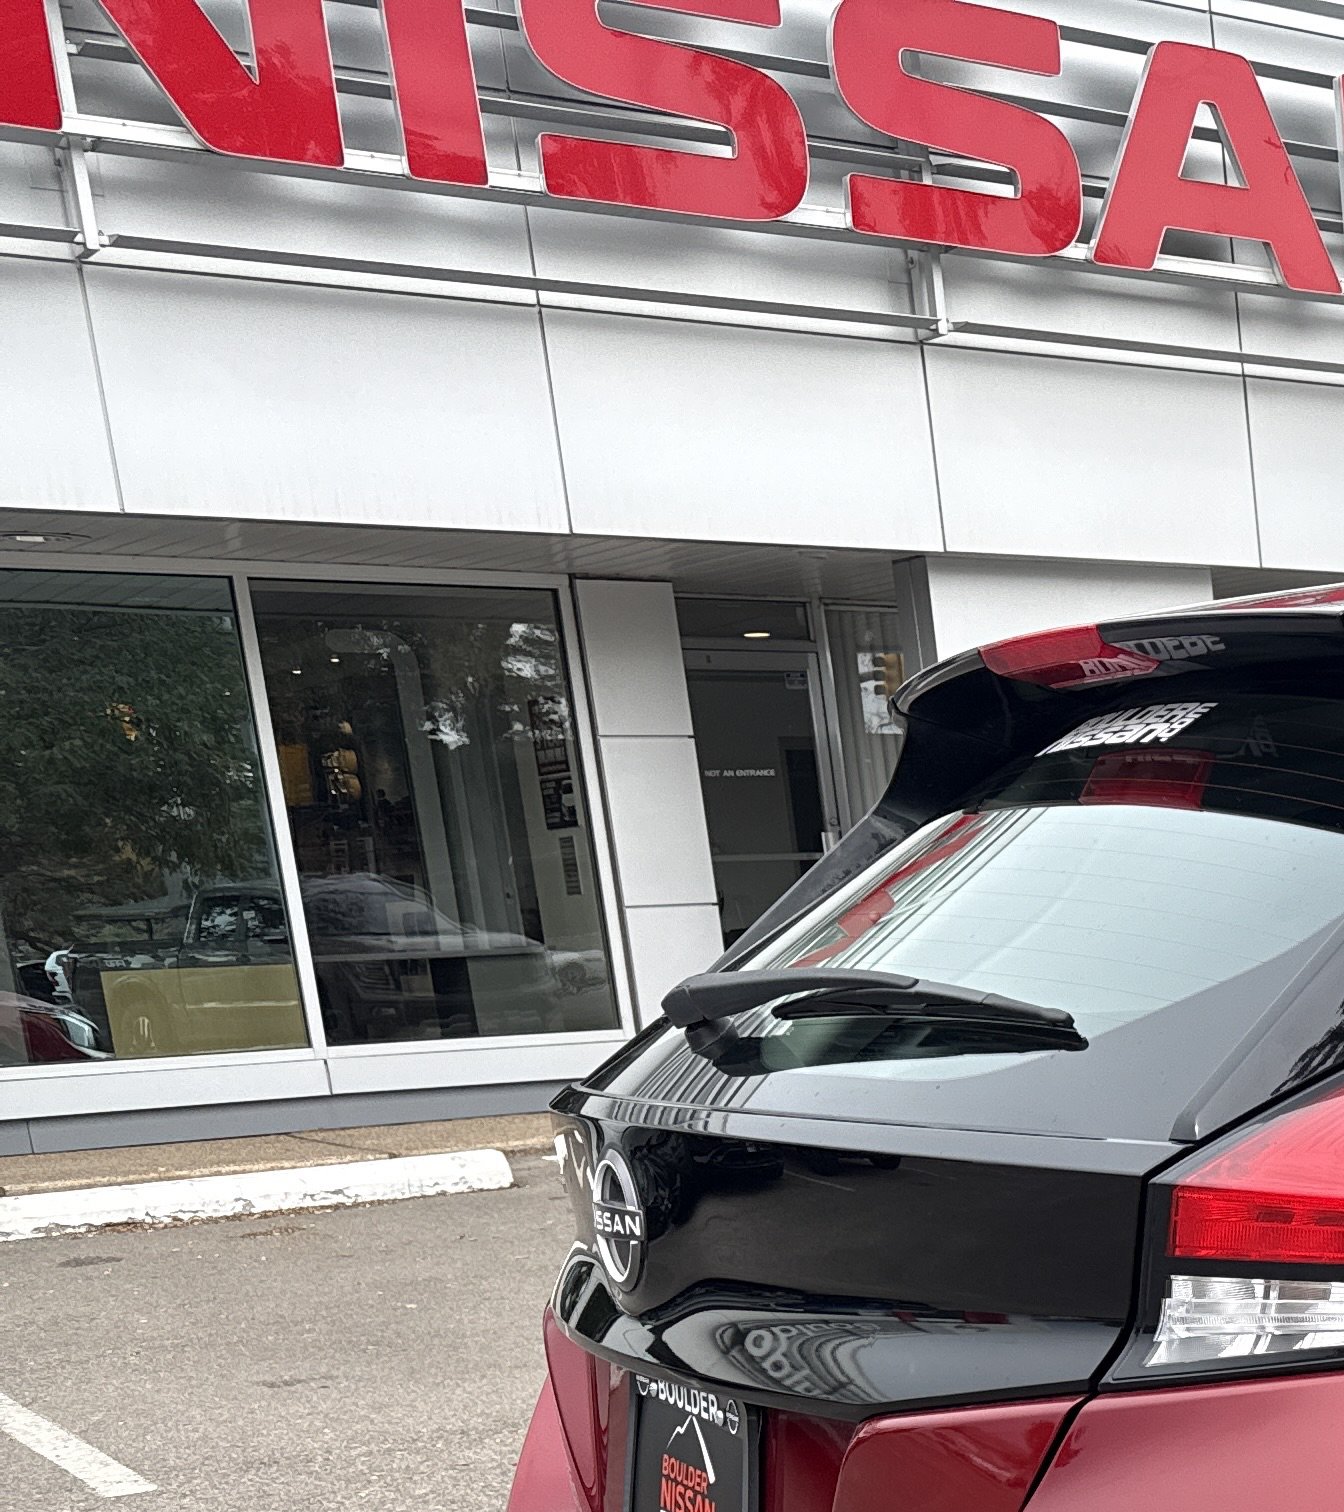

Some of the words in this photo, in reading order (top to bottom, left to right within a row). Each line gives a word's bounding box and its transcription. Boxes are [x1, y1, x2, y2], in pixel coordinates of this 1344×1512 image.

[704, 769, 721, 777] NOT
[723, 769, 735, 777] AN
[735, 768, 776, 777] ENTRANCE
[658, 1380, 718, 1423] BOULDER
[661, 1453, 708, 1495] BOULDER
